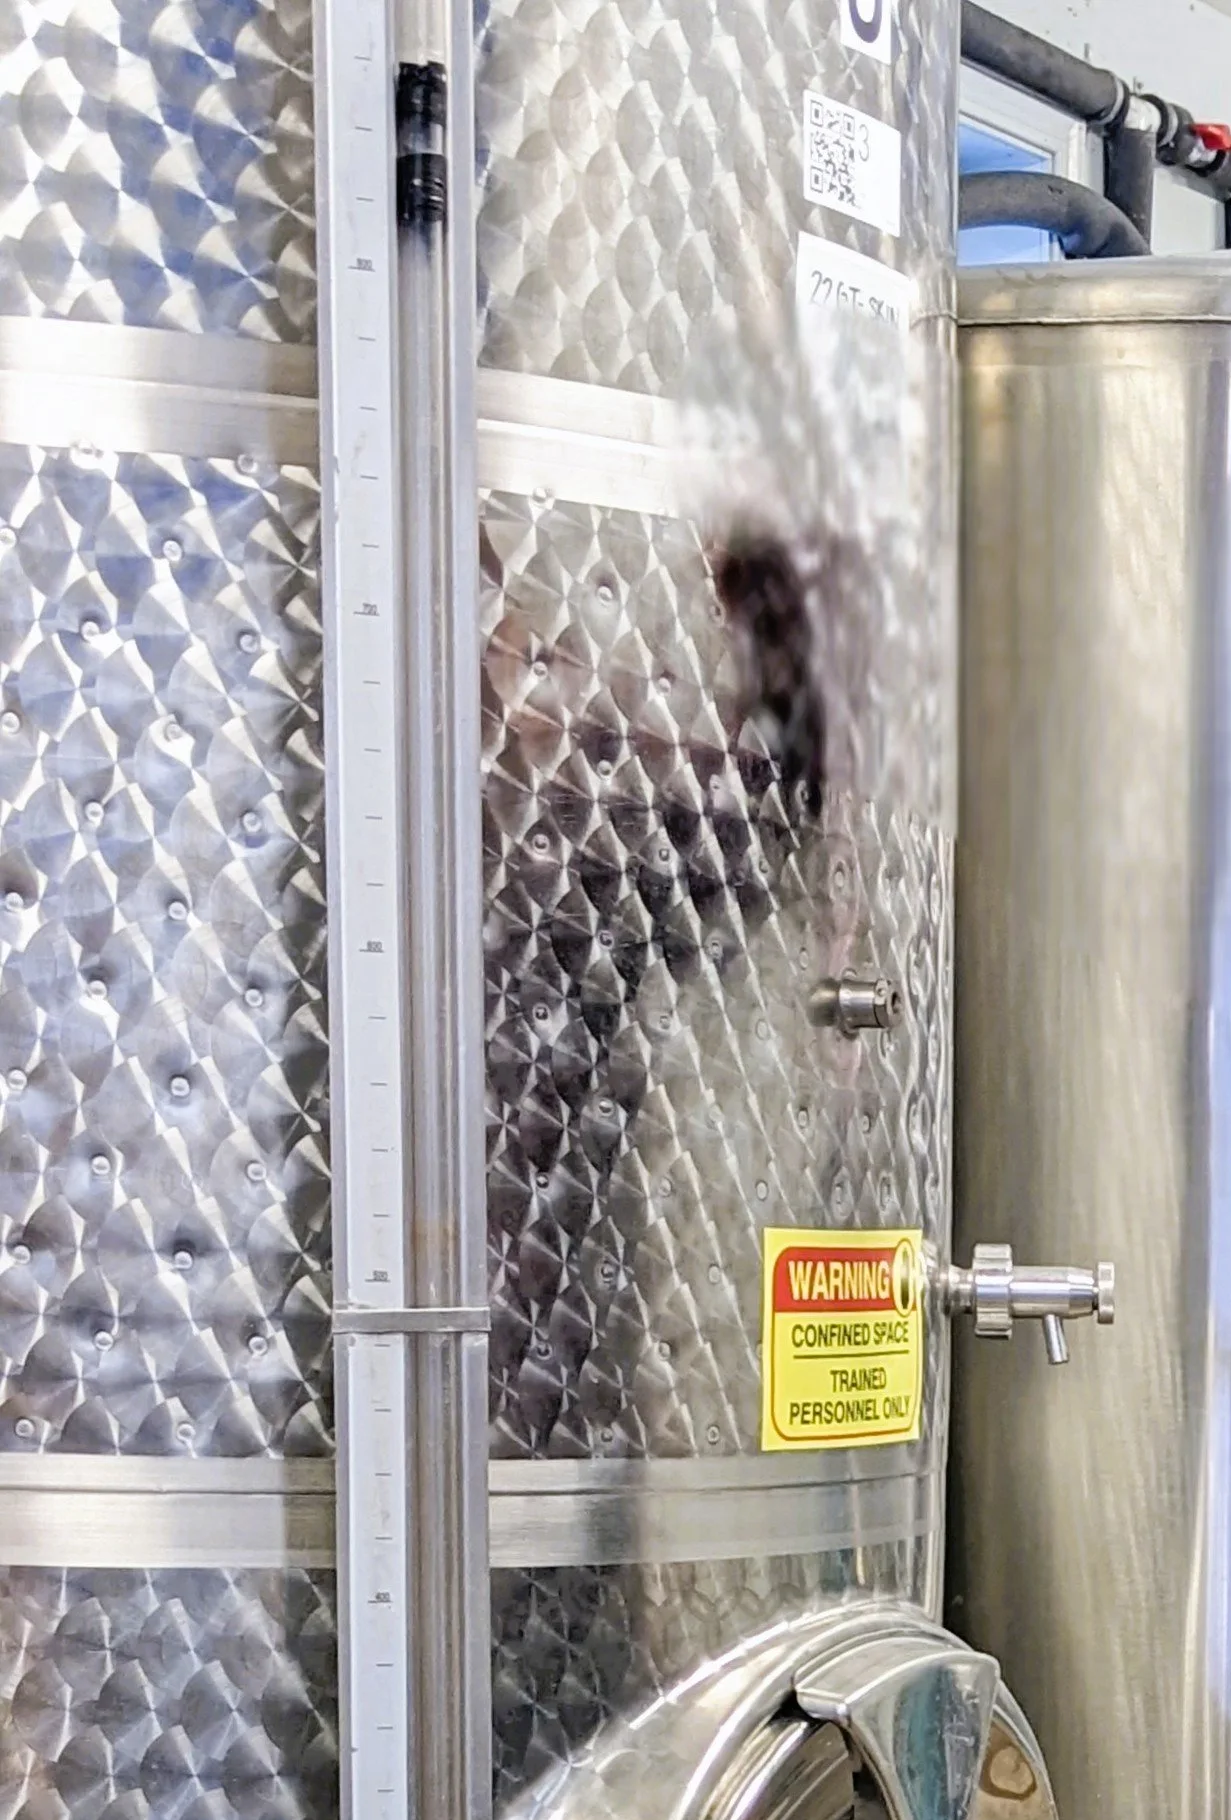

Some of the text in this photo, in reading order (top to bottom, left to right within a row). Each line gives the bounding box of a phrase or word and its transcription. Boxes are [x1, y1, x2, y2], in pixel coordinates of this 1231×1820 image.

[788, 1260, 891, 1301] WARNING
[791, 1321, 909, 1348] CONFINED SPACE
[830, 1367, 887, 1393] TRAINED
[788, 1395, 911, 1425] PERSONNEL ONLY
